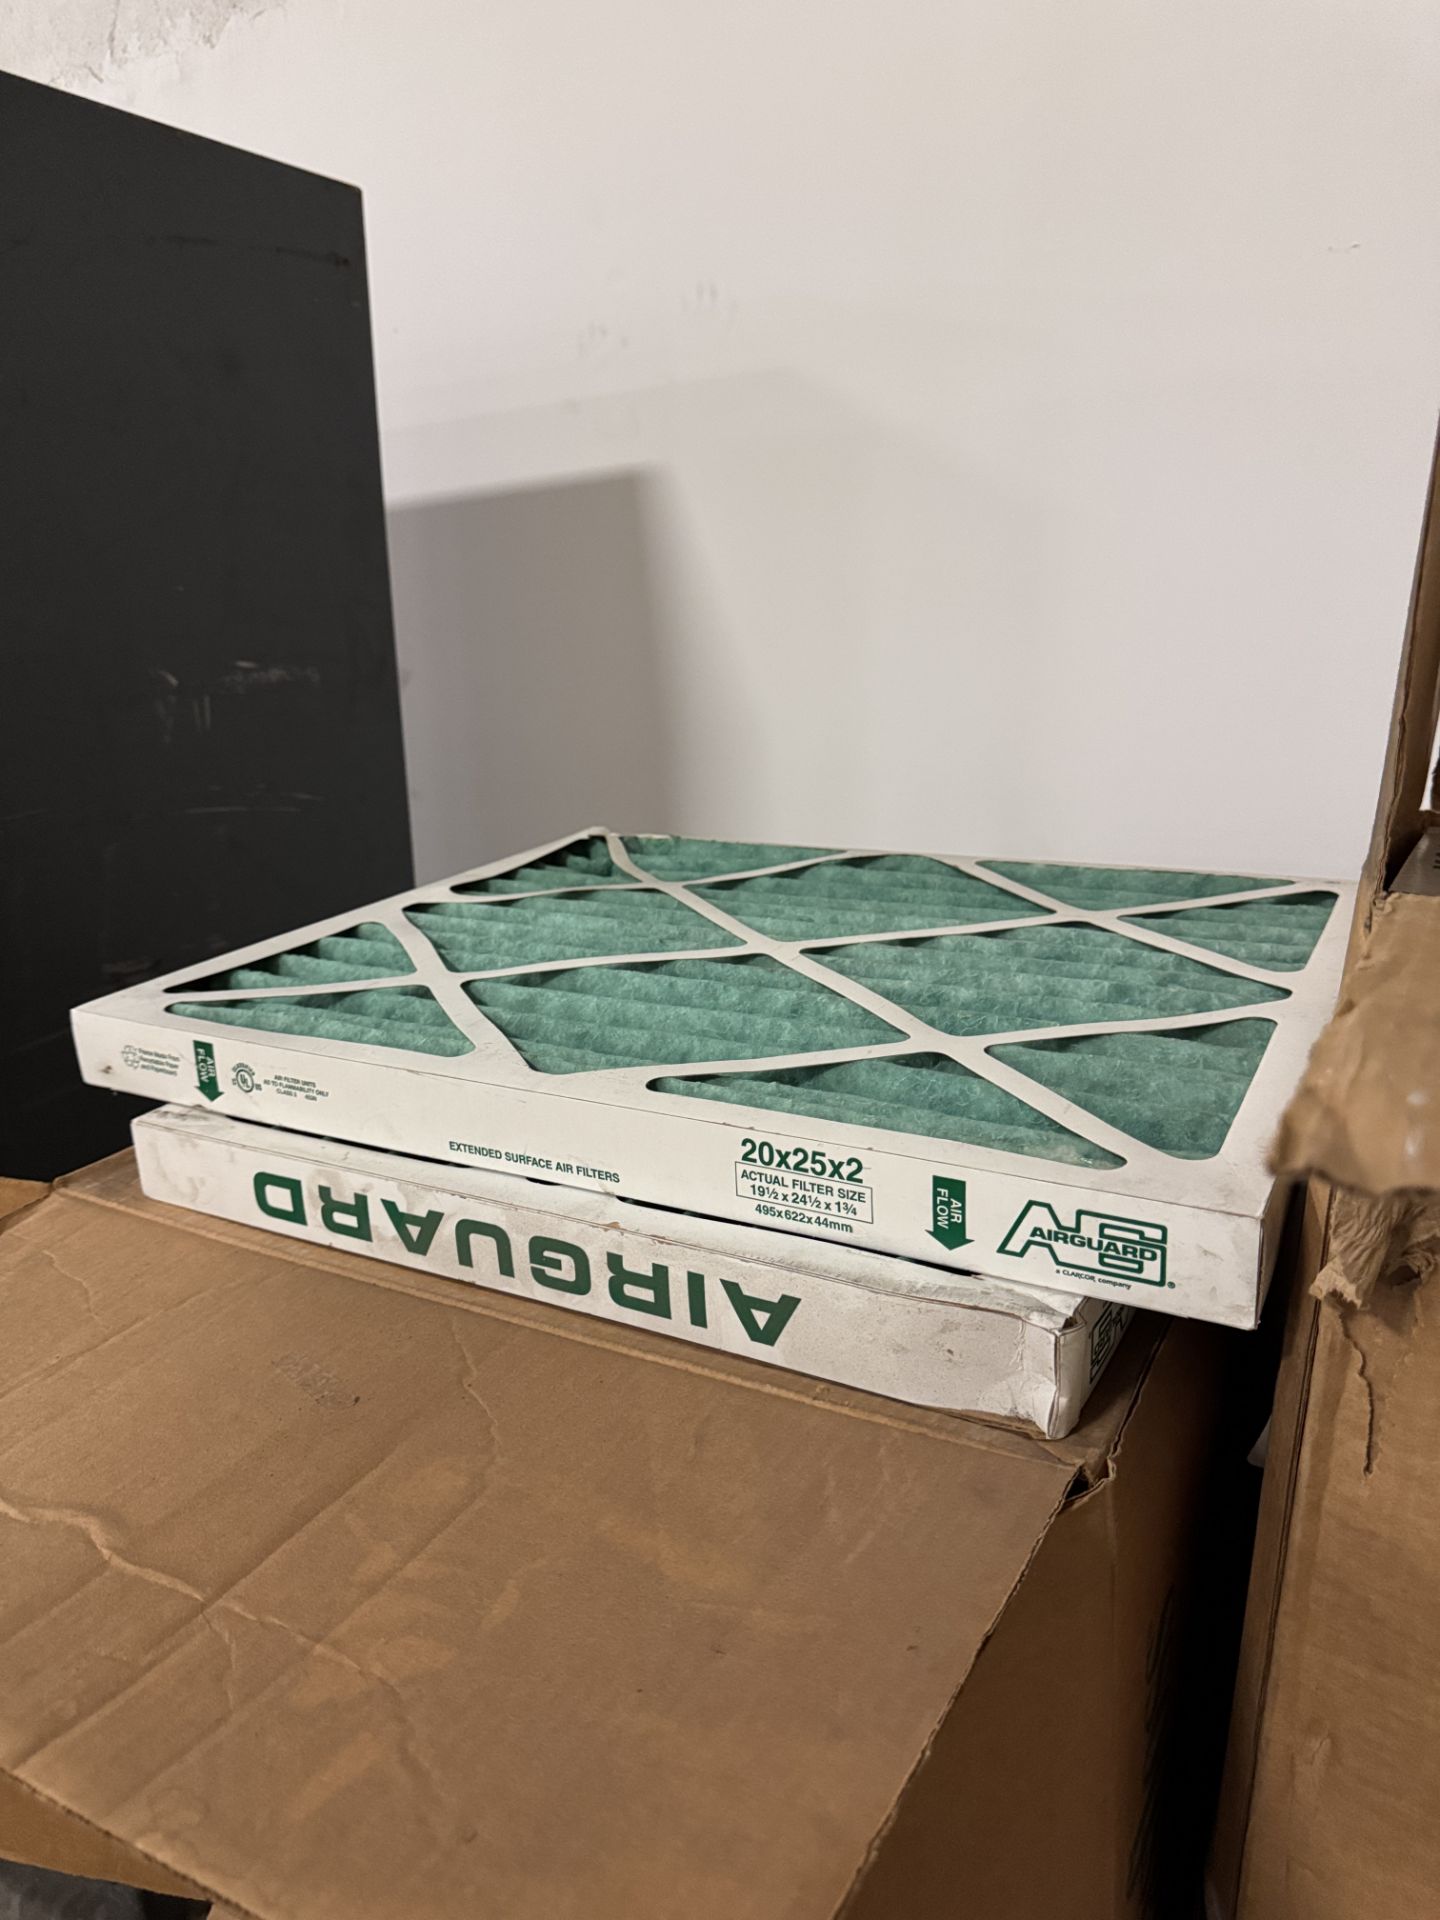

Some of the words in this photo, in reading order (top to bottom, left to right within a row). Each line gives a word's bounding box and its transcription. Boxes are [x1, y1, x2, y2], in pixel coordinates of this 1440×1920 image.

[196, 1048, 209, 1083] FLOW
[206, 1056, 216, 1077] AIR
[284, 1076, 301, 1084] FILTER
[449, 1141, 502, 1160] EXTENDED
[505, 1151, 552, 1170] SURFACE
[555, 1162, 573, 1174] AIR
[576, 1166, 620, 1183] FILTERS
[741, 1138, 864, 1184] 20x25x2
[741, 1169, 788, 1188] ACTUAL
[792, 1179, 833, 1197] FILTER
[838, 1188, 866, 1203] SIZE
[781, 1193, 788, 1202] x
[824, 1202, 832, 1211] x
[936, 1187, 949, 1230] FLOW
[950, 1198, 962, 1224] AIR
[253, 1171, 802, 1347] AIRGUARD
[1030, 1226, 1158, 1262] AIRGUARD
[1098, 1277, 1132, 1290] company
